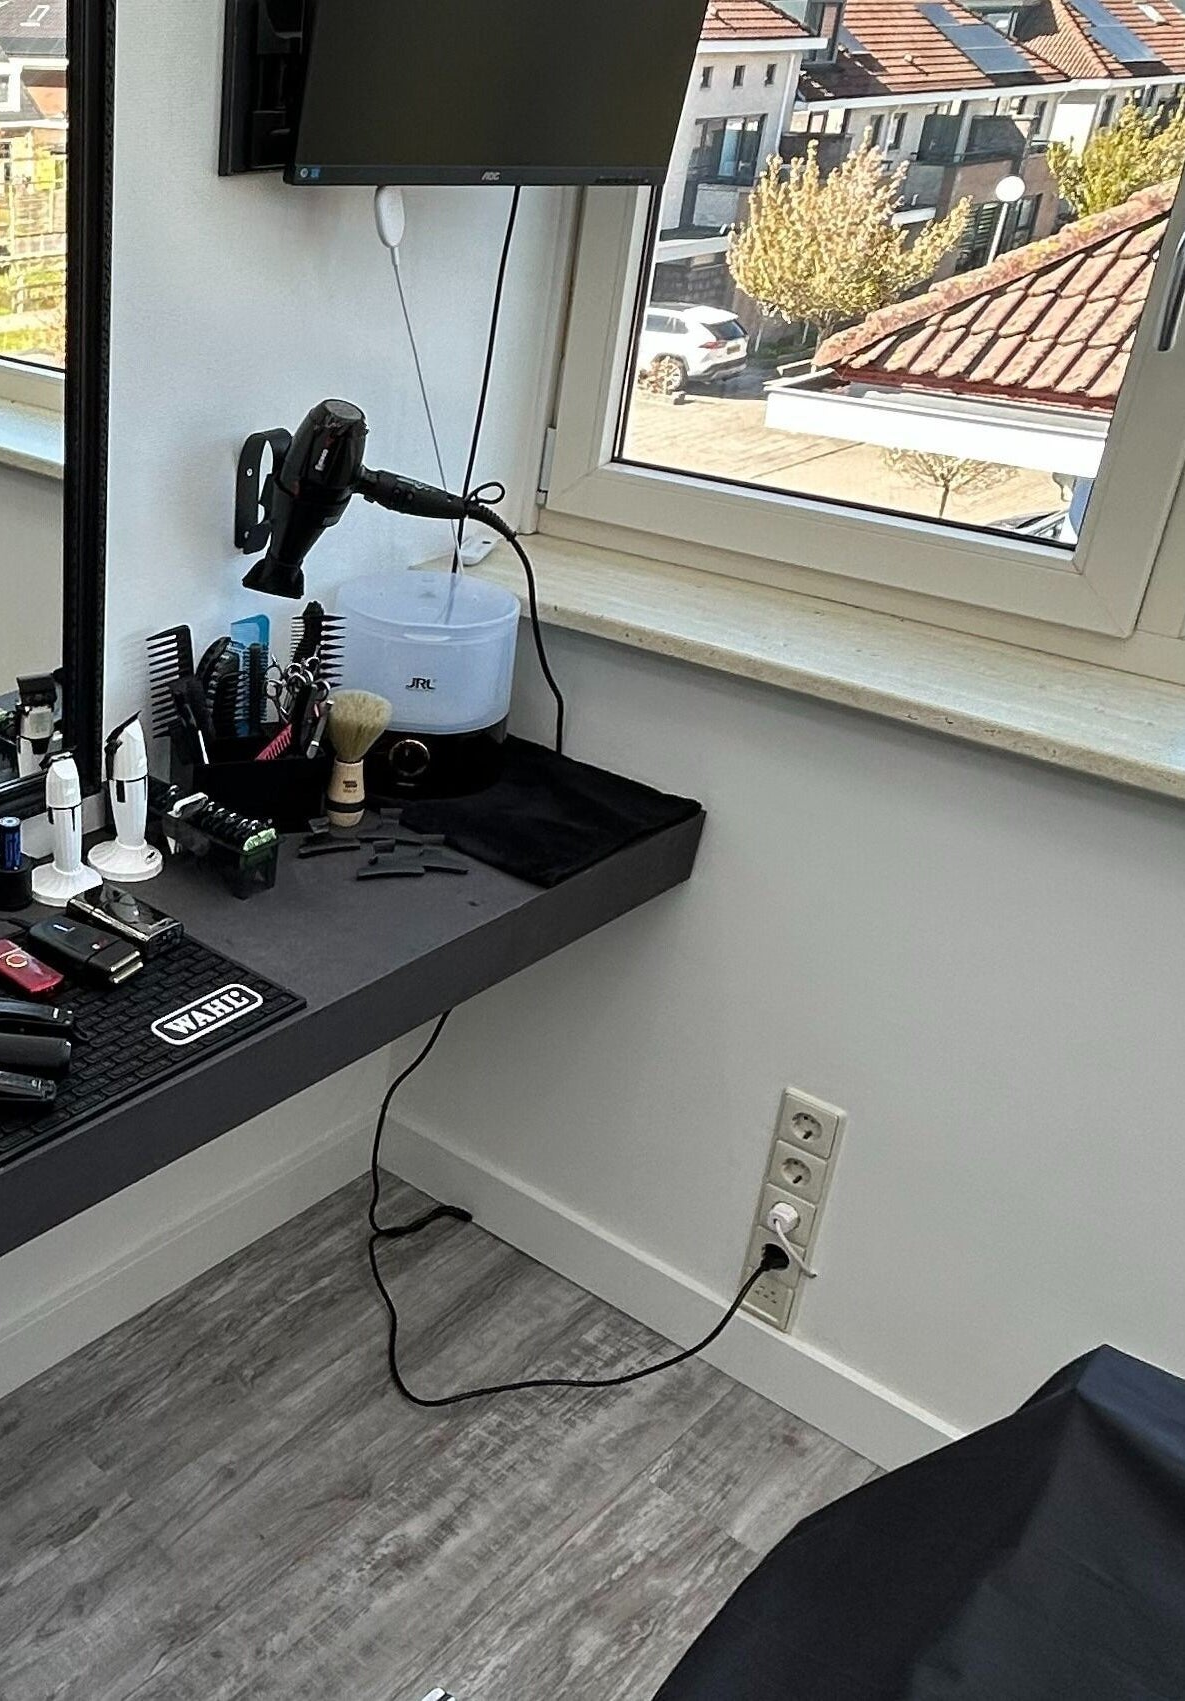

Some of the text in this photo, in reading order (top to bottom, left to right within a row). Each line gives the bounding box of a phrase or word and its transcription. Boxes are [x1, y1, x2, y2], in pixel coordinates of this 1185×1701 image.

[481, 171, 501, 181] AOC
[405, 677, 436, 690] JRL
[163, 990, 250, 1034] WAHL
